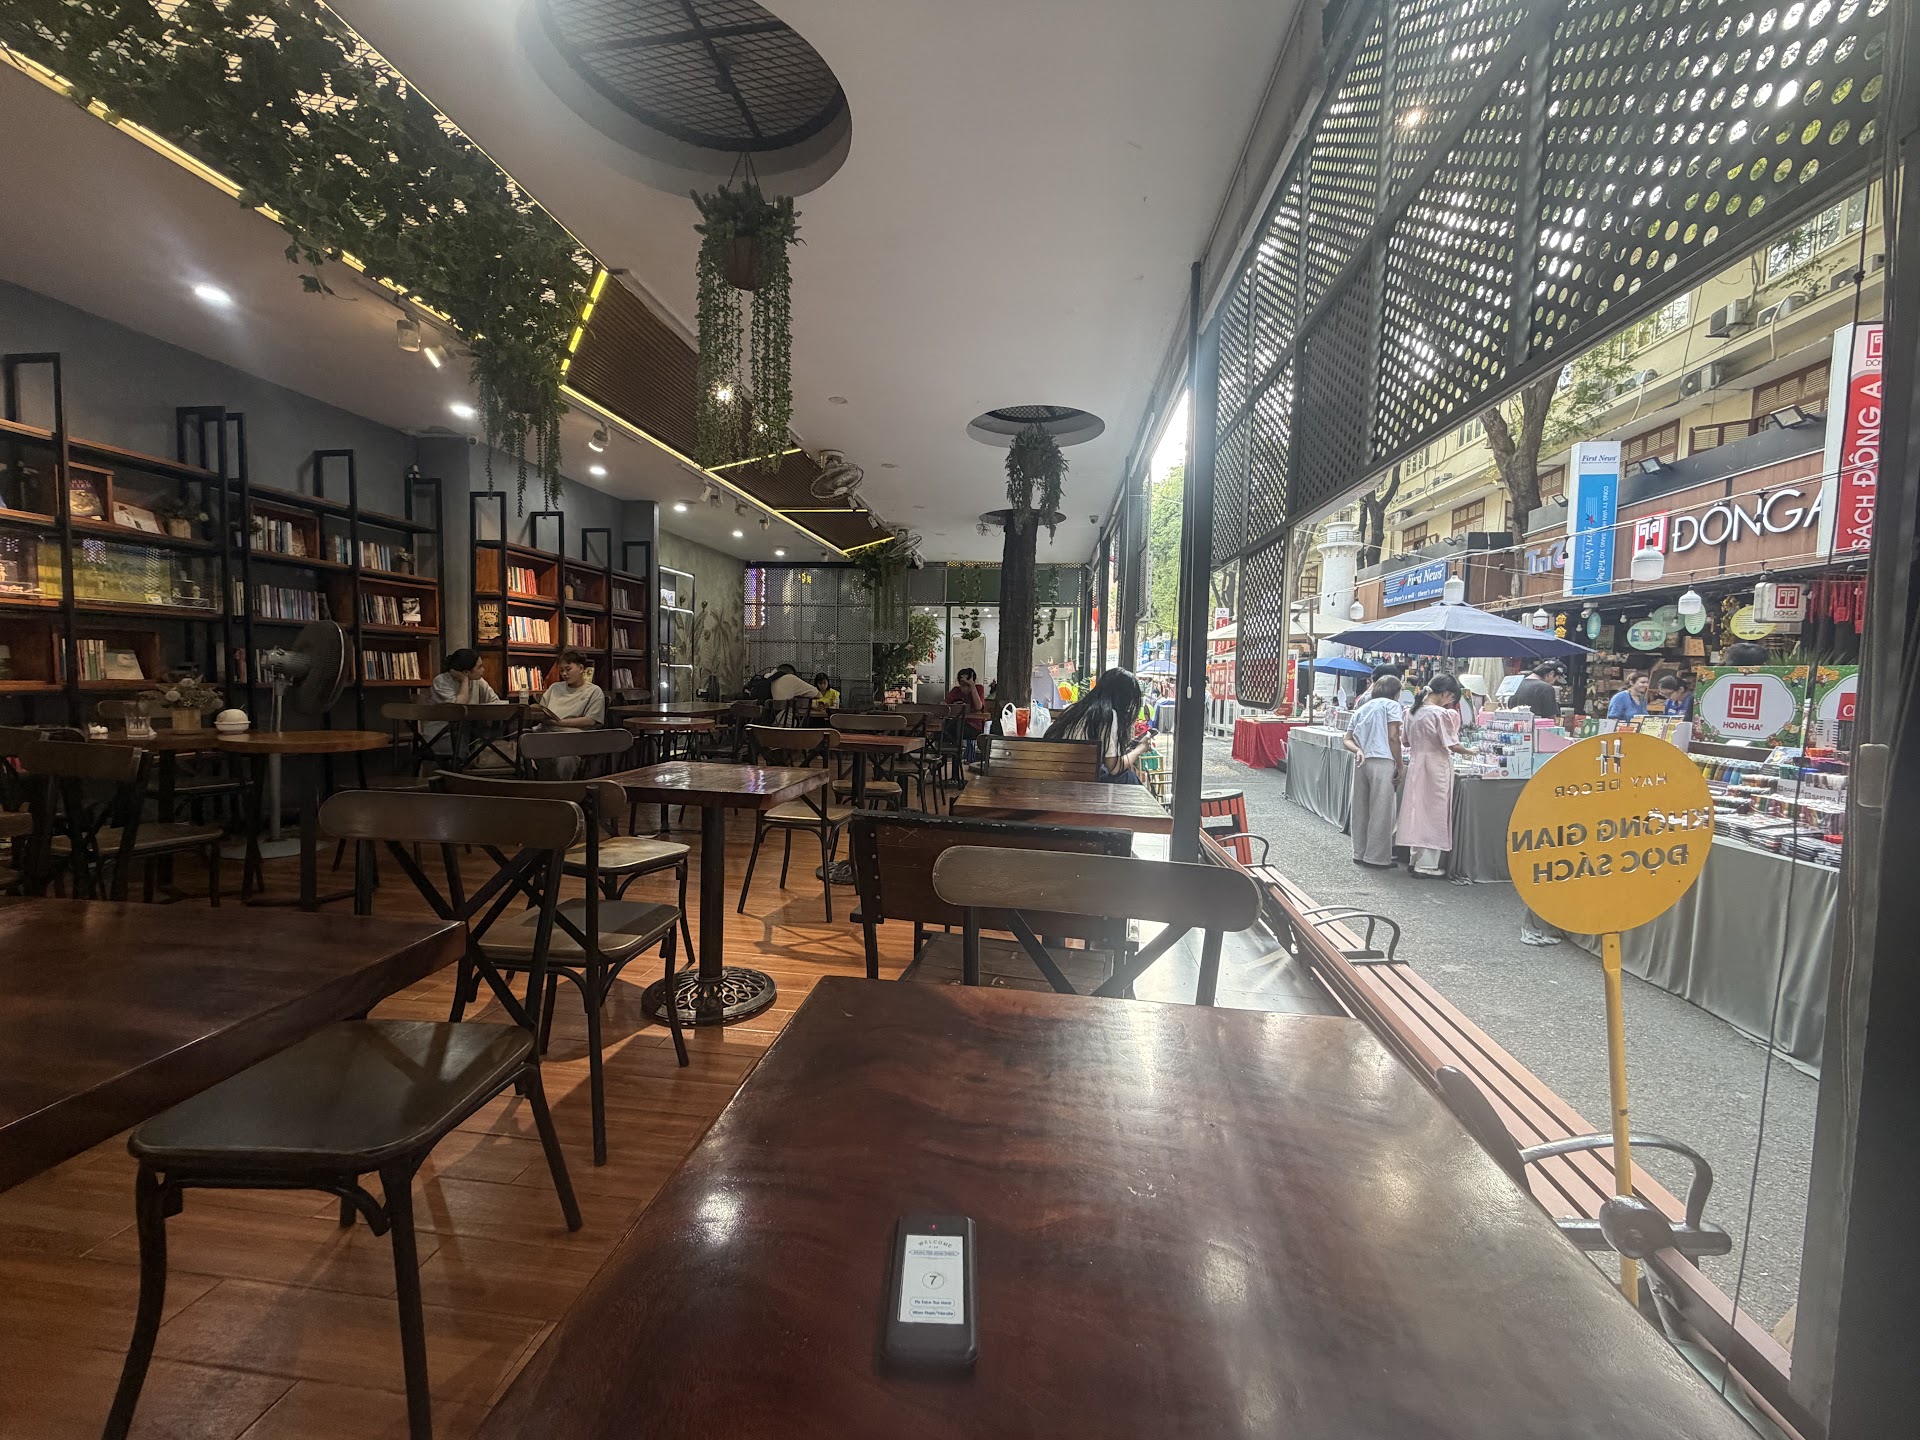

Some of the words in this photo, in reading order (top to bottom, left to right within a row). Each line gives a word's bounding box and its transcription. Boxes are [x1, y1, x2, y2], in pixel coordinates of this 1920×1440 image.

[1860, 380, 1882, 399] A
[1848, 406, 1881, 488] ĐÔNG
[1847, 495, 1875, 550] SÁCH
[1723, 721, 1747, 731] HONG
[918, 1240, 952, 1249] WELCOME
[930, 1275, 937, 1285] 7
